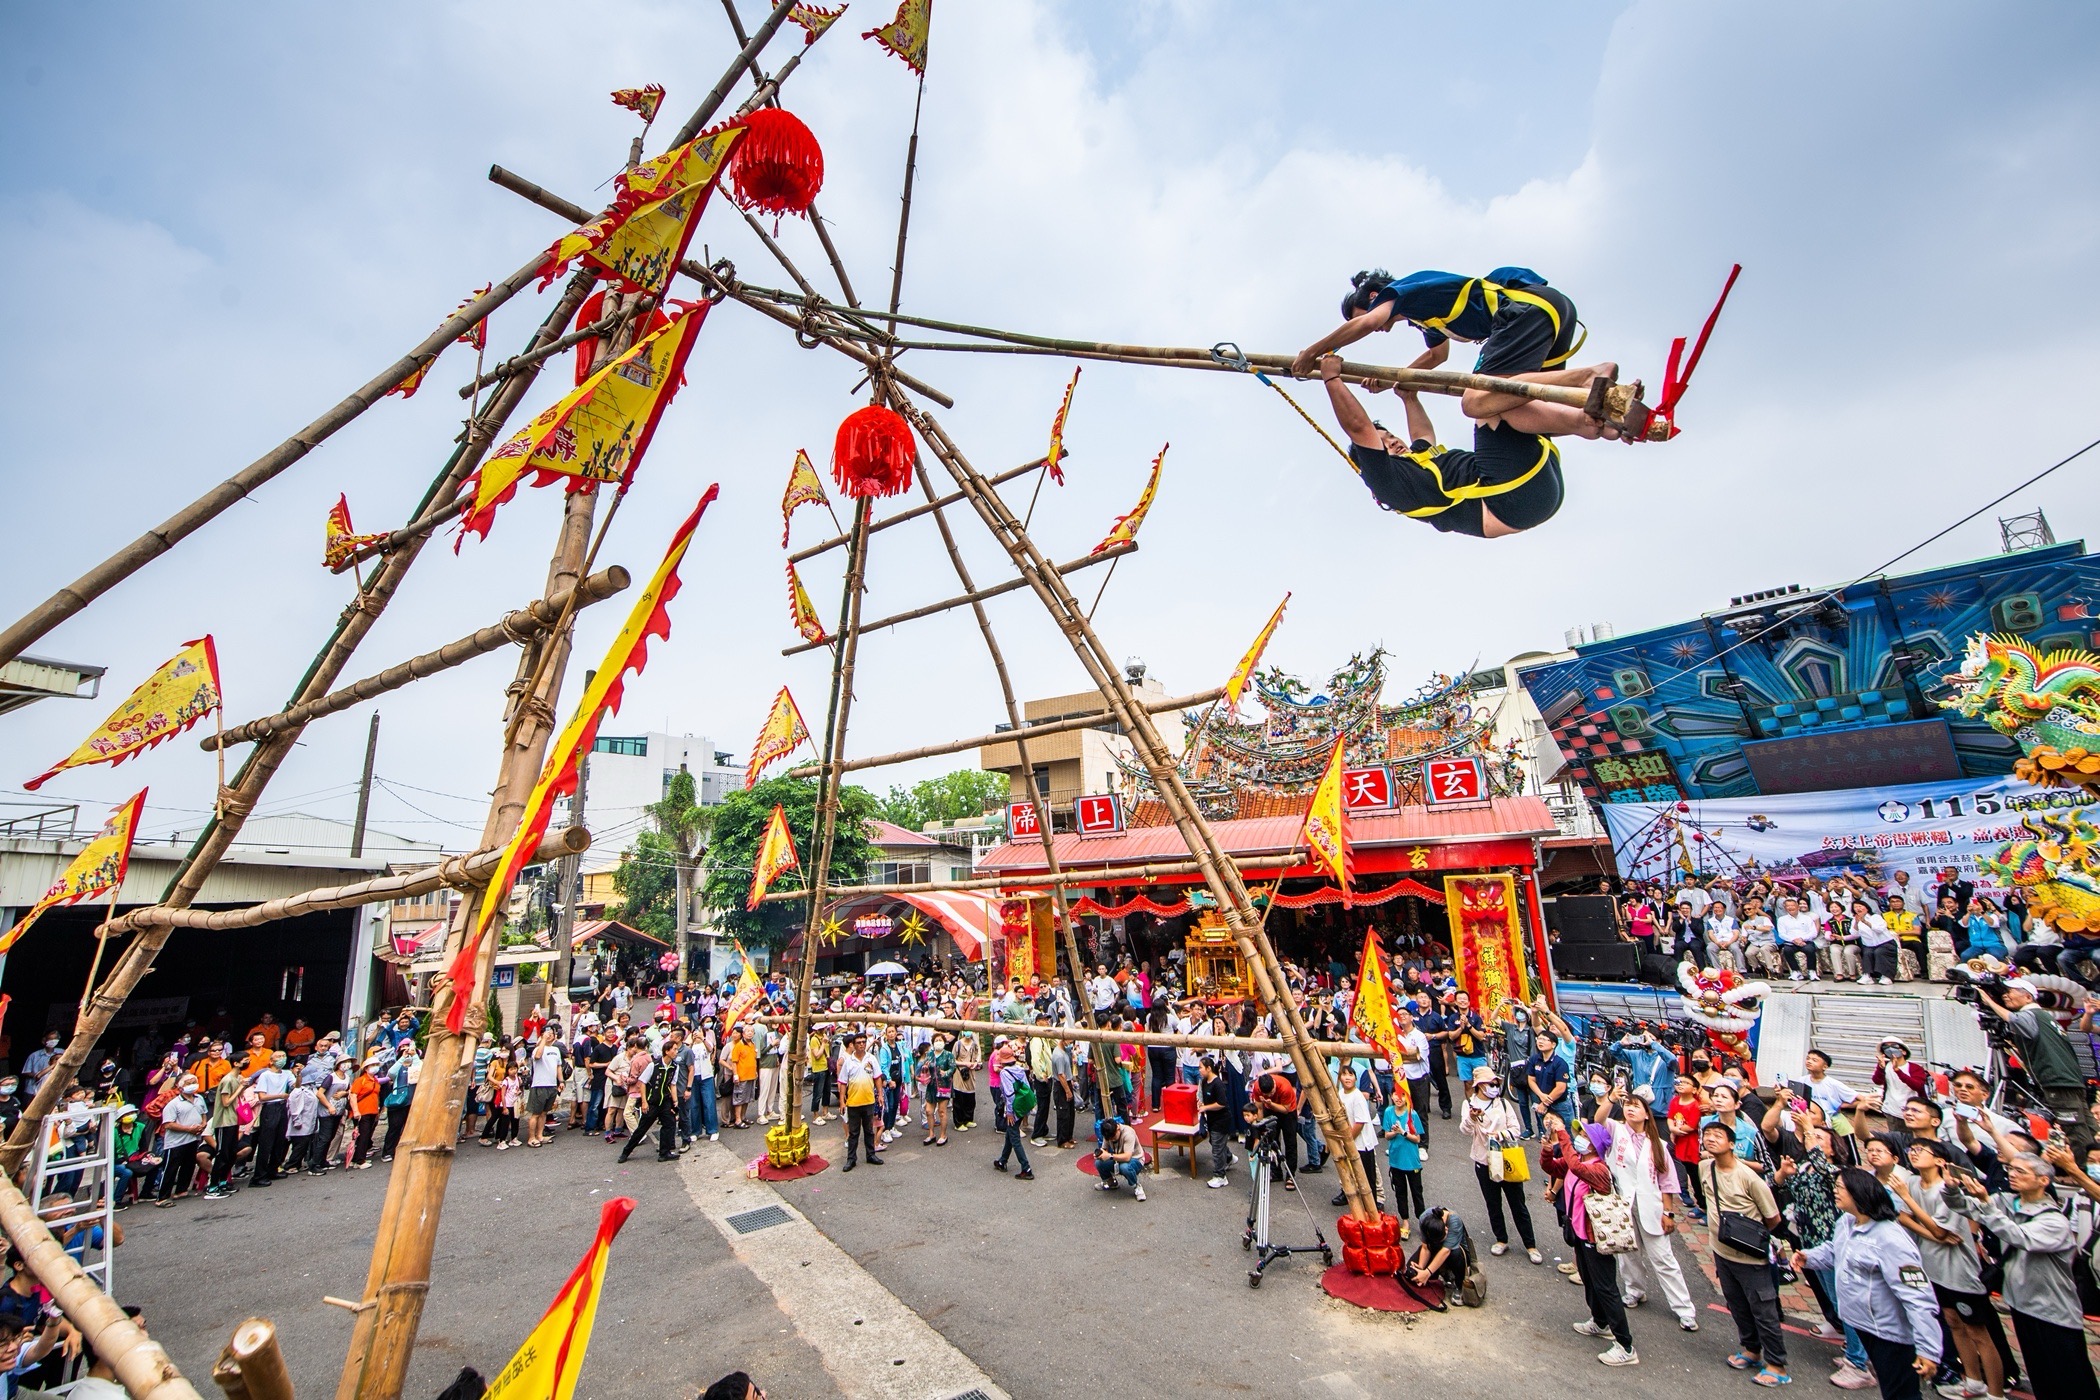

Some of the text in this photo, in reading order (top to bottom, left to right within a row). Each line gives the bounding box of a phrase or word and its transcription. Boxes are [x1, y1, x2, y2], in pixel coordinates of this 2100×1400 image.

[1434, 764, 1471, 797] 玄
[1593, 755, 1670, 783] 歡迎
[1350, 773, 1386, 805] 天
[1016, 805, 1037, 832] 帝
[1086, 801, 1112, 828] 上
[1406, 845, 1431, 870] 玄
